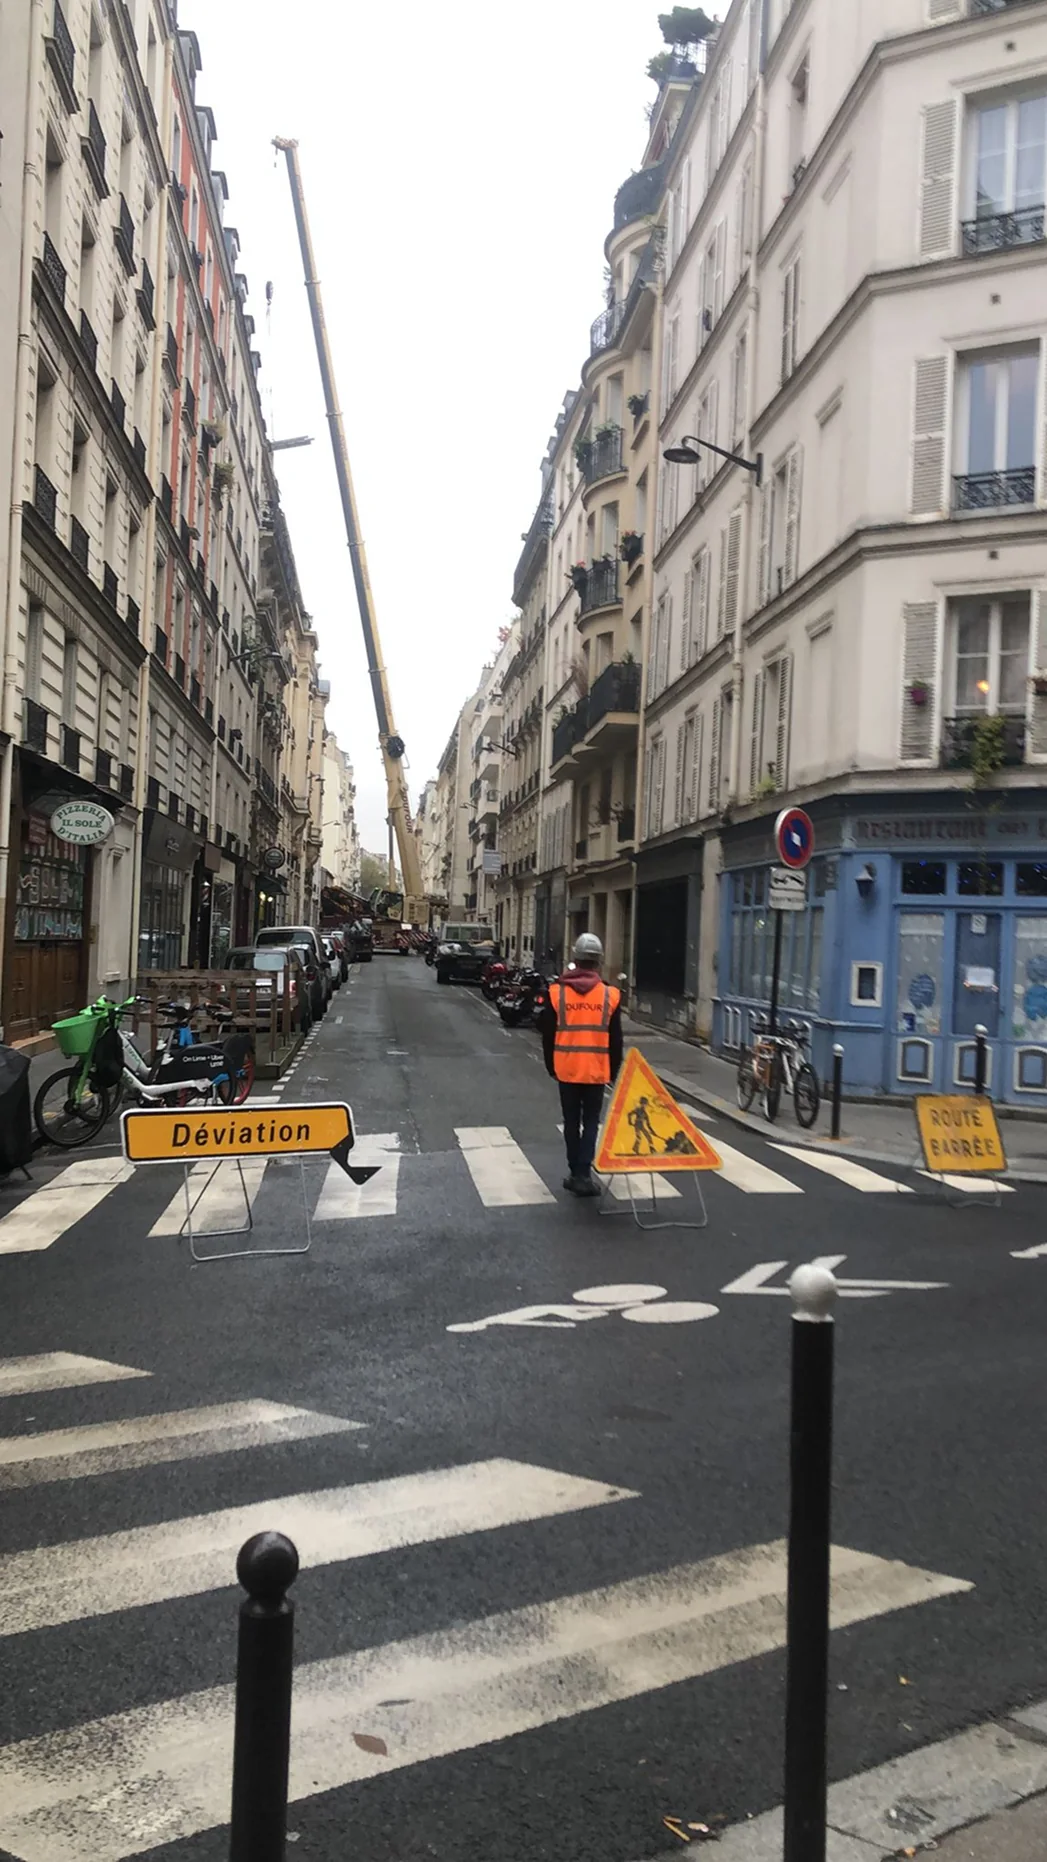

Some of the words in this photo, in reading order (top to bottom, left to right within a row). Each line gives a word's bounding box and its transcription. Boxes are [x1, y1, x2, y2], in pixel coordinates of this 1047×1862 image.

[56, 805, 106, 822] PIZZERIA
[62, 819, 73, 827] IL
[75, 820, 102, 828] SOLE
[57, 827, 105, 841] D'ITALIA
[565, 1003, 603, 1012] DUFOUR
[931, 1109, 983, 1127] ROUTE
[172, 1120, 311, 1147] Déviation
[931, 1134, 996, 1157] BARRÉE
